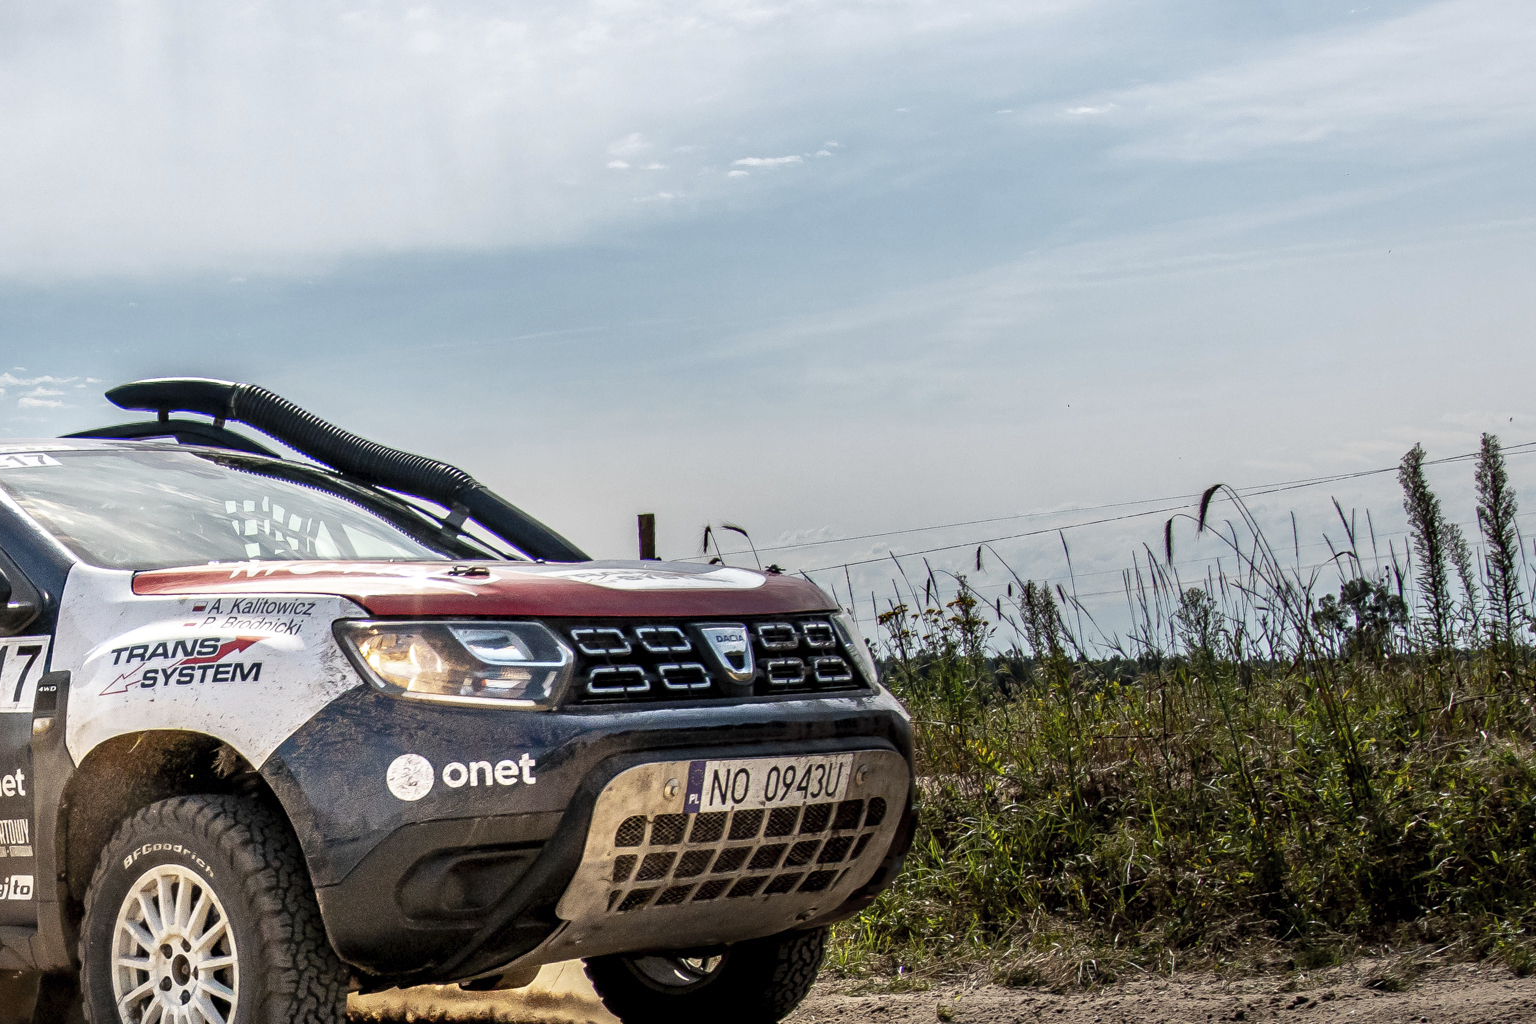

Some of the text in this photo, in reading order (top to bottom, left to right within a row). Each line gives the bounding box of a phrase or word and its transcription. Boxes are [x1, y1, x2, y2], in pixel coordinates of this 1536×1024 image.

[208, 598, 316, 617] A. Kalitowicz
[199, 616, 303, 636] P. Brodnicki
[716, 634, 744, 643] DACIA
[111, 637, 220, 665] TRANS
[140, 662, 262, 688] SYSTEM
[442, 753, 536, 788] onet
[709, 762, 844, 806] NO 0943U
[688, 793, 699, 804] PL
[123, 843, 214, 878] BFGoodrich
